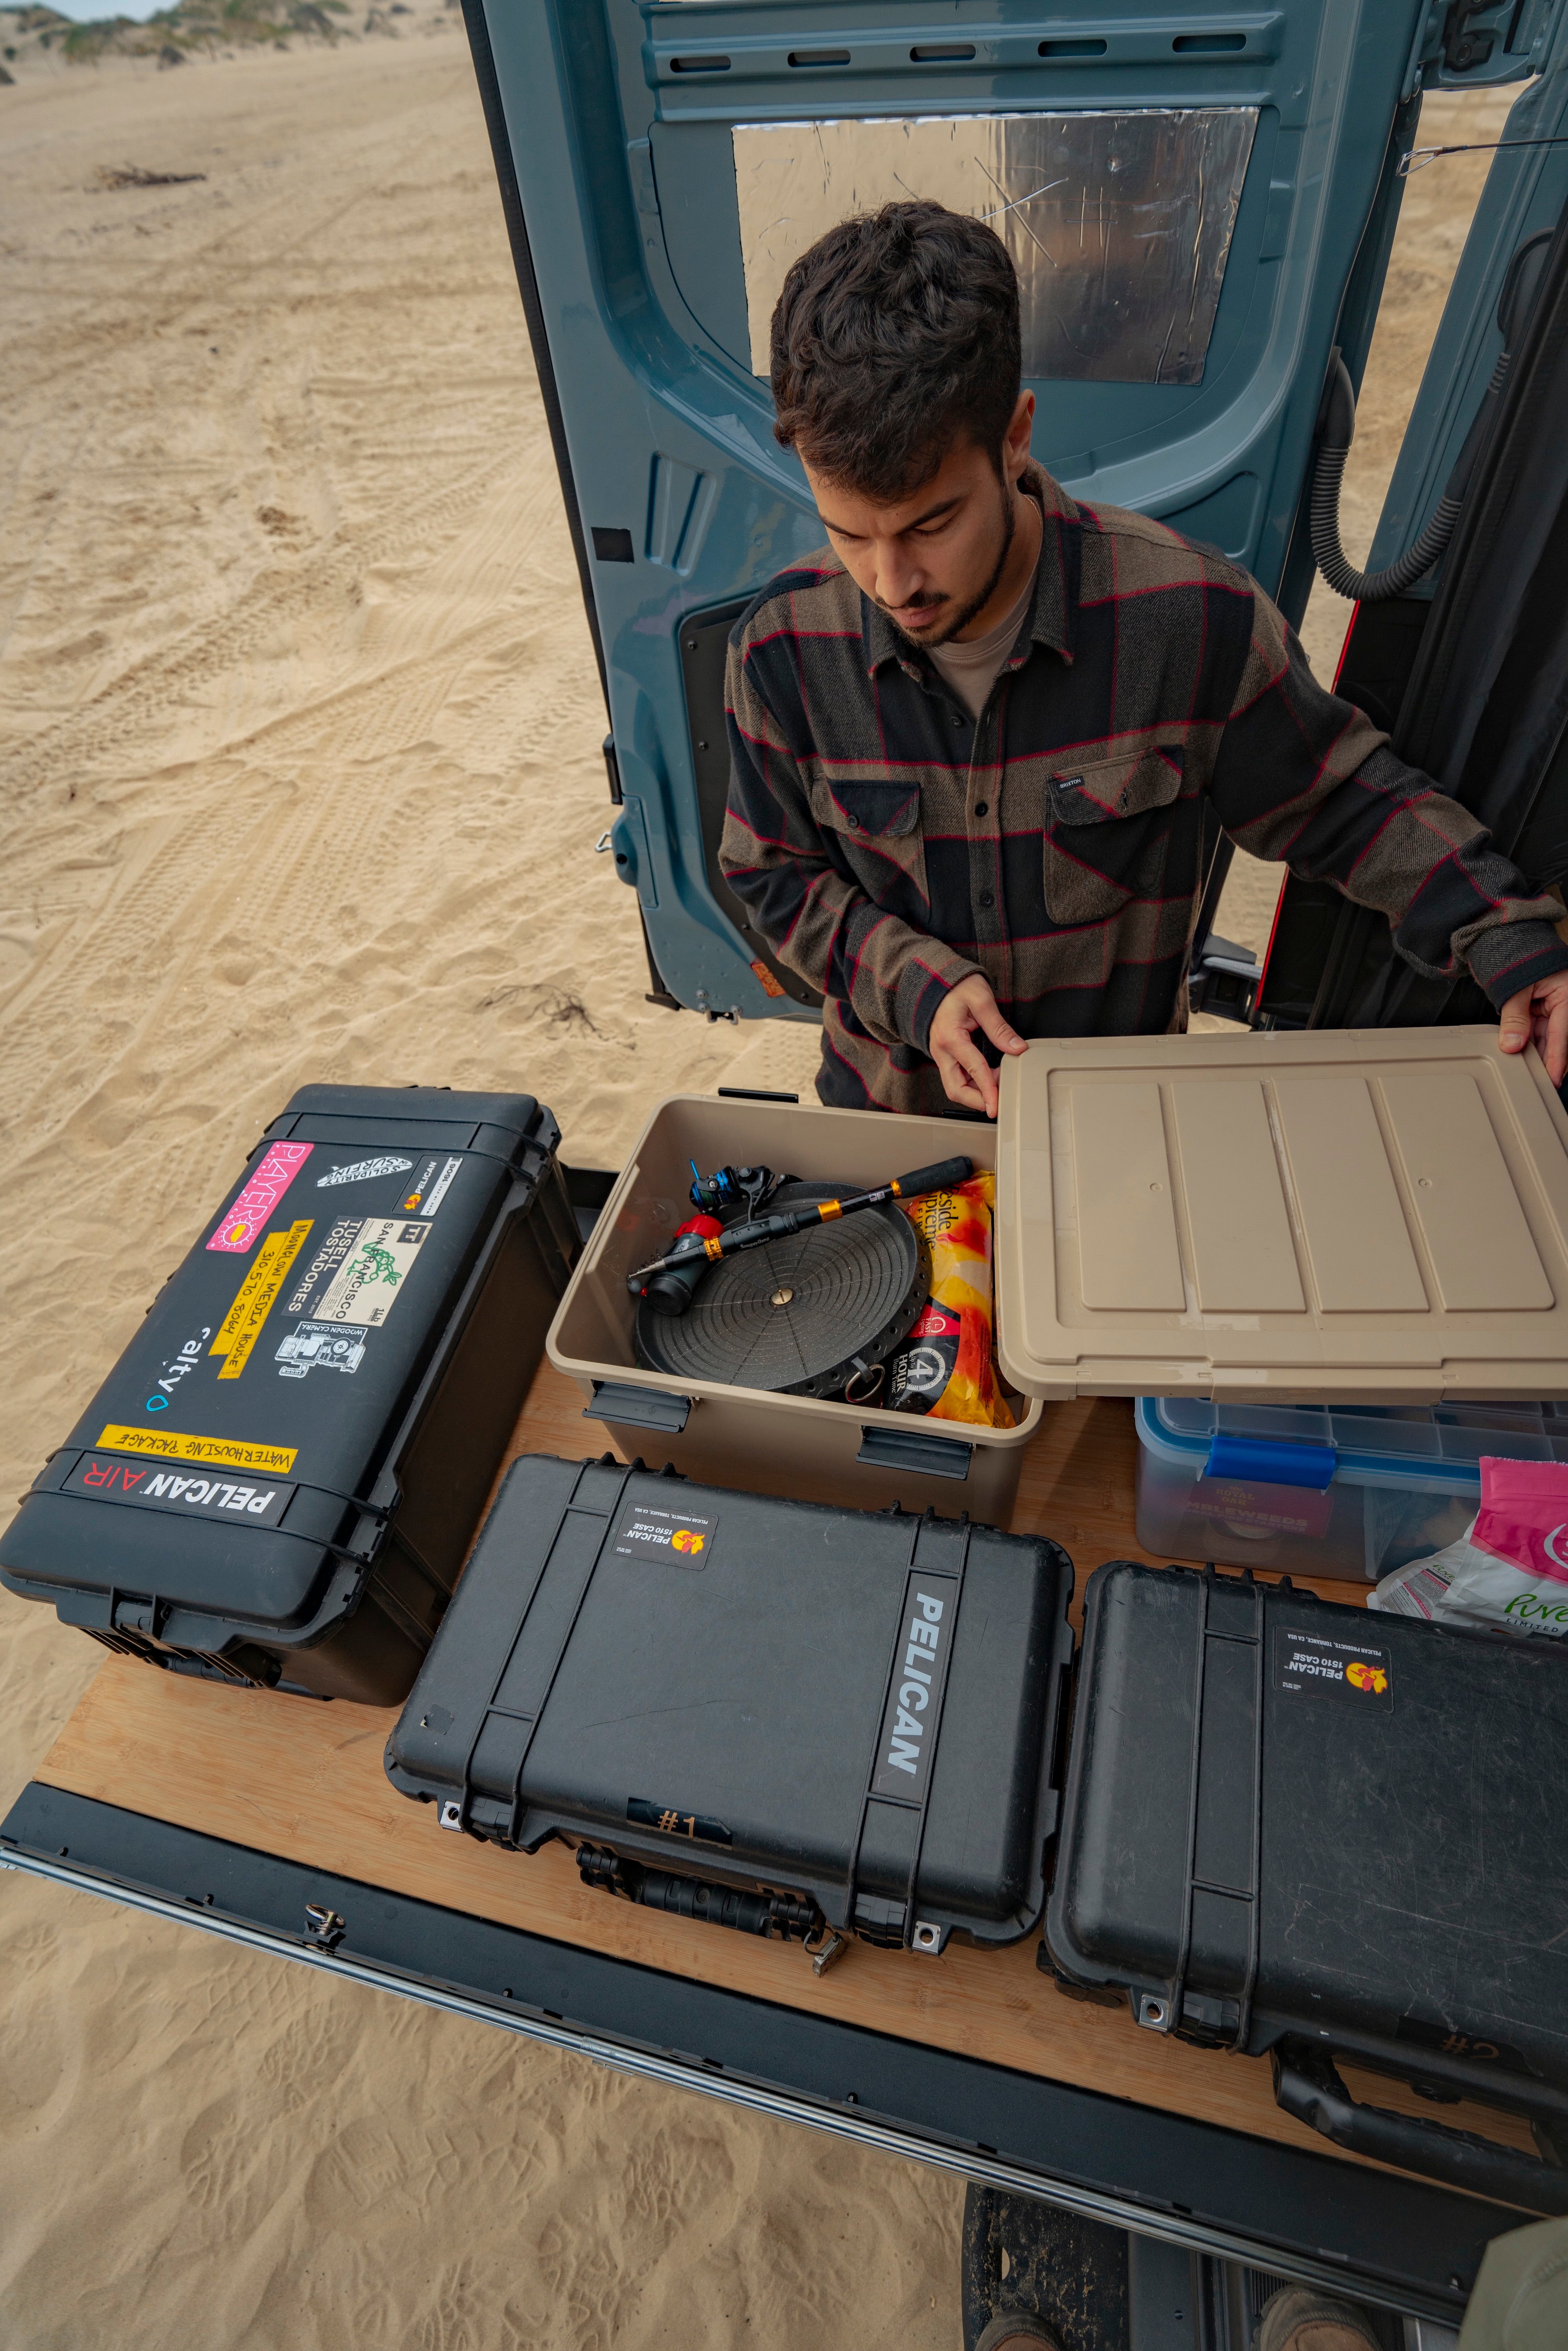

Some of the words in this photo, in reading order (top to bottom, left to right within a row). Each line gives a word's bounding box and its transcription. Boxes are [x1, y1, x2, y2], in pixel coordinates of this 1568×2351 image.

[1060, 778, 1081, 789] BRIXTON
[252, 1144, 280, 1183] PUERTO
[327, 1158, 399, 1179] SURFING
[324, 1165, 401, 1186] SOLIDARITY
[415, 1161, 437, 1194] PELICAN
[426, 1201, 434, 1213] MADE
[442, 1163, 456, 1182] 1606
[229, 1194, 248, 1219] RICO
[374, 1222, 394, 1244] SAN
[272, 1225, 308, 1276] MOONGLOW
[323, 1220, 363, 1272] TUSELL
[740, 1237, 770, 1249] Sougayilang
[286, 1219, 350, 1312] TOSTADORES
[334, 1249, 379, 1319] FRANCISCO
[247, 1283, 276, 1326] MEDIA
[307, 1304, 316, 1313] 2013
[313, 1295, 321, 1303] EST.
[372, 1308, 385, 1322] 1Lb
[302, 1324, 330, 1332] CAMERA
[331, 1327, 363, 1336] WOODEN
[229, 1333, 253, 1367] HOUSE
[896, 1354, 908, 1393] HOUR
[907, 1359, 933, 1379] 4
[114, 1434, 179, 1453] PACKAGE
[83, 1462, 147, 1491] AIR
[143, 1473, 276, 1514] PELICAN
[1216, 1488, 1254, 1500] ROYAL
[1222, 1497, 1247, 1506] OAK
[649, 1510, 669, 1518] TORRANCE,
[671, 1514, 692, 1522] PRODUCTS,
[626, 1530, 671, 1544] PELICAN
[633, 1523, 655, 1532] CASE
[655, 1527, 672, 1536] 1510
[1422, 1571, 1447, 1590] INGREDIEN
[1419, 1602, 1431, 1618] GARAN
[1506, 1618, 1559, 1633] LIMITED
[1305, 1637, 1332, 1647] TORRANCE,
[1333, 1642, 1360, 1652] PRODUCTS,
[1293, 1652, 1319, 1664] CASE
[1361, 1648, 1381, 1656] PELICAN
[1288, 1661, 1344, 1680] PELICAN
[1321, 1659, 1343, 1669] 1510
[888, 1592, 944, 1775] PELICAN
[658, 1810, 695, 1838] #1
[1439, 2034, 1500, 2060] #2
